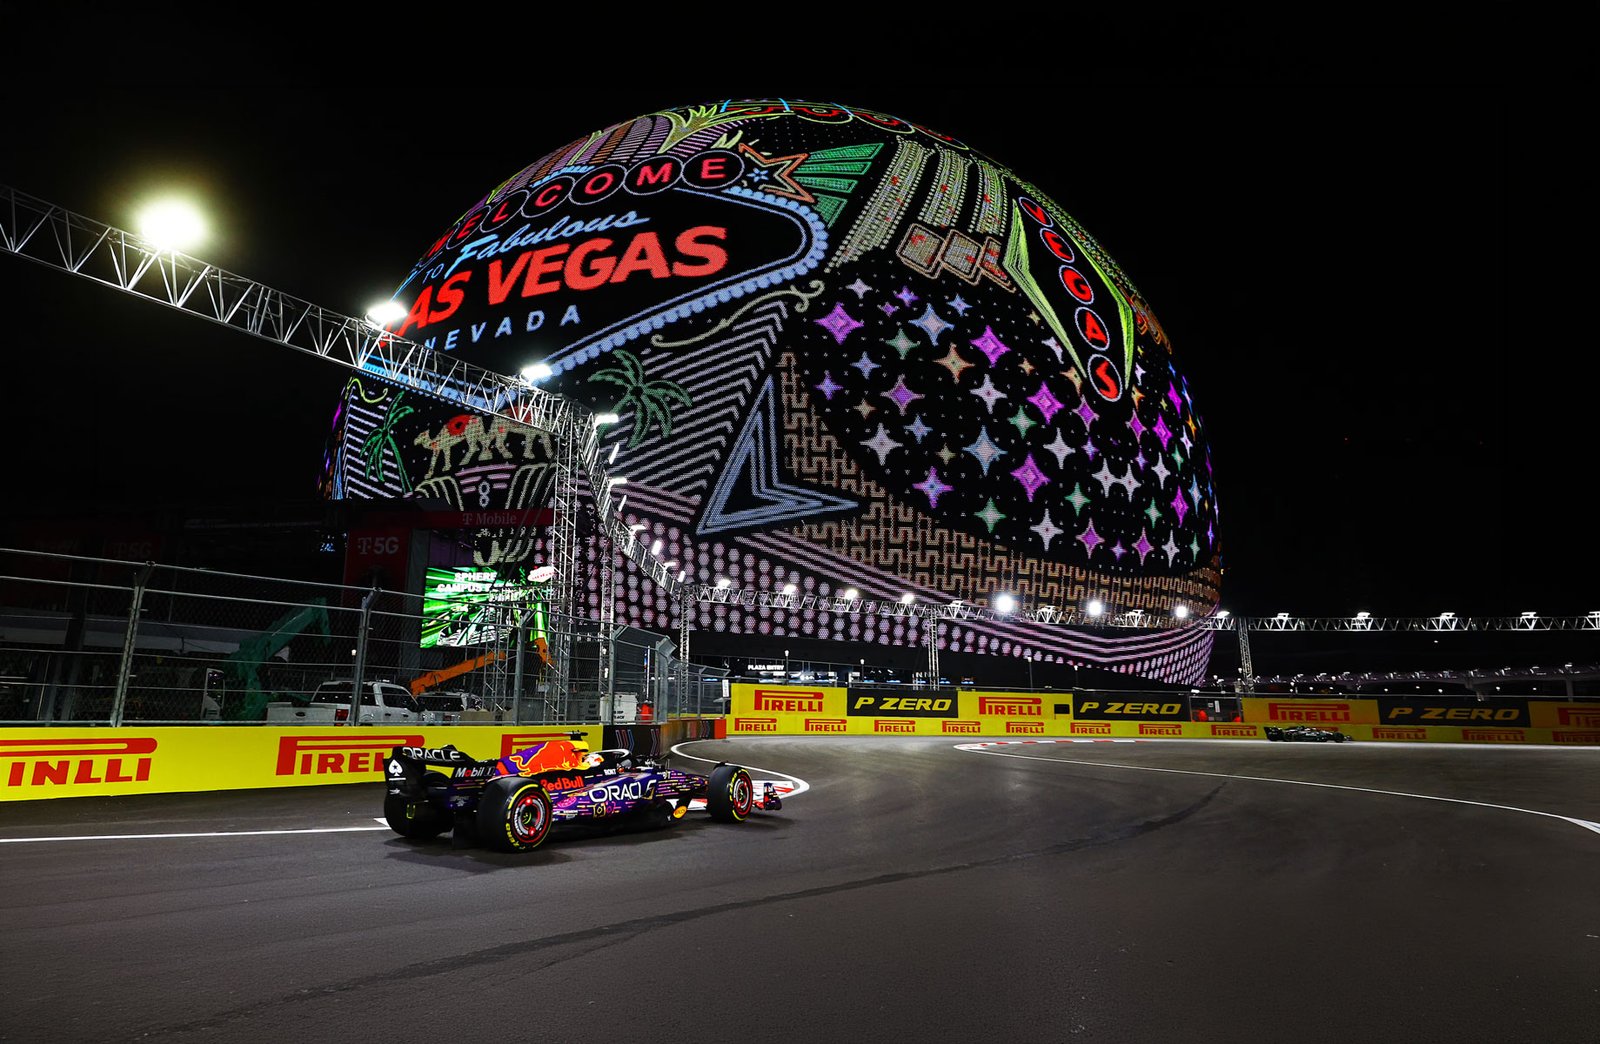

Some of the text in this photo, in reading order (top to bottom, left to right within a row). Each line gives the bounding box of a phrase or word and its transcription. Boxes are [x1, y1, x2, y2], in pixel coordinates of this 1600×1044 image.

[427, 156, 727, 258] WELCOME
[422, 210, 652, 284] TO Fabulous
[487, 226, 728, 306] VEGAS
[424, 304, 580, 351] NEVADA
[475, 512, 518, 526] Mobile
[454, 572, 498, 582] SPHERE
[754, 689, 824, 713] PIRELLI
[853, 697, 952, 711] P ZERO
[978, 696, 1042, 716] PIRELLI
[1079, 701, 1182, 715] P ZERO
[1268, 702, 1351, 722] PIRELLI
[1388, 707, 1520, 721] P ZERO
[734, 717, 777, 732] PIRELLI
[804, 718, 847, 732] PIRELLI
[873, 719, 916, 733] PIRELLI
[942, 720, 981, 733] PIRELLI
[1006, 721, 1045, 734] PIRELLI
[1070, 722, 1111, 735] PIRELLI
[1138, 723, 1182, 736] PIRELLI
[1210, 724, 1257, 737] PIRELLI
[1372, 727, 1427, 740] PIRELLI
[275, 734, 425, 776] PIREL
[401, 746, 462, 762] ORACLE
[455, 766, 484, 778] Mobil
[562, 775, 585, 790] Bull
[588, 779, 657, 803] ORACLE
